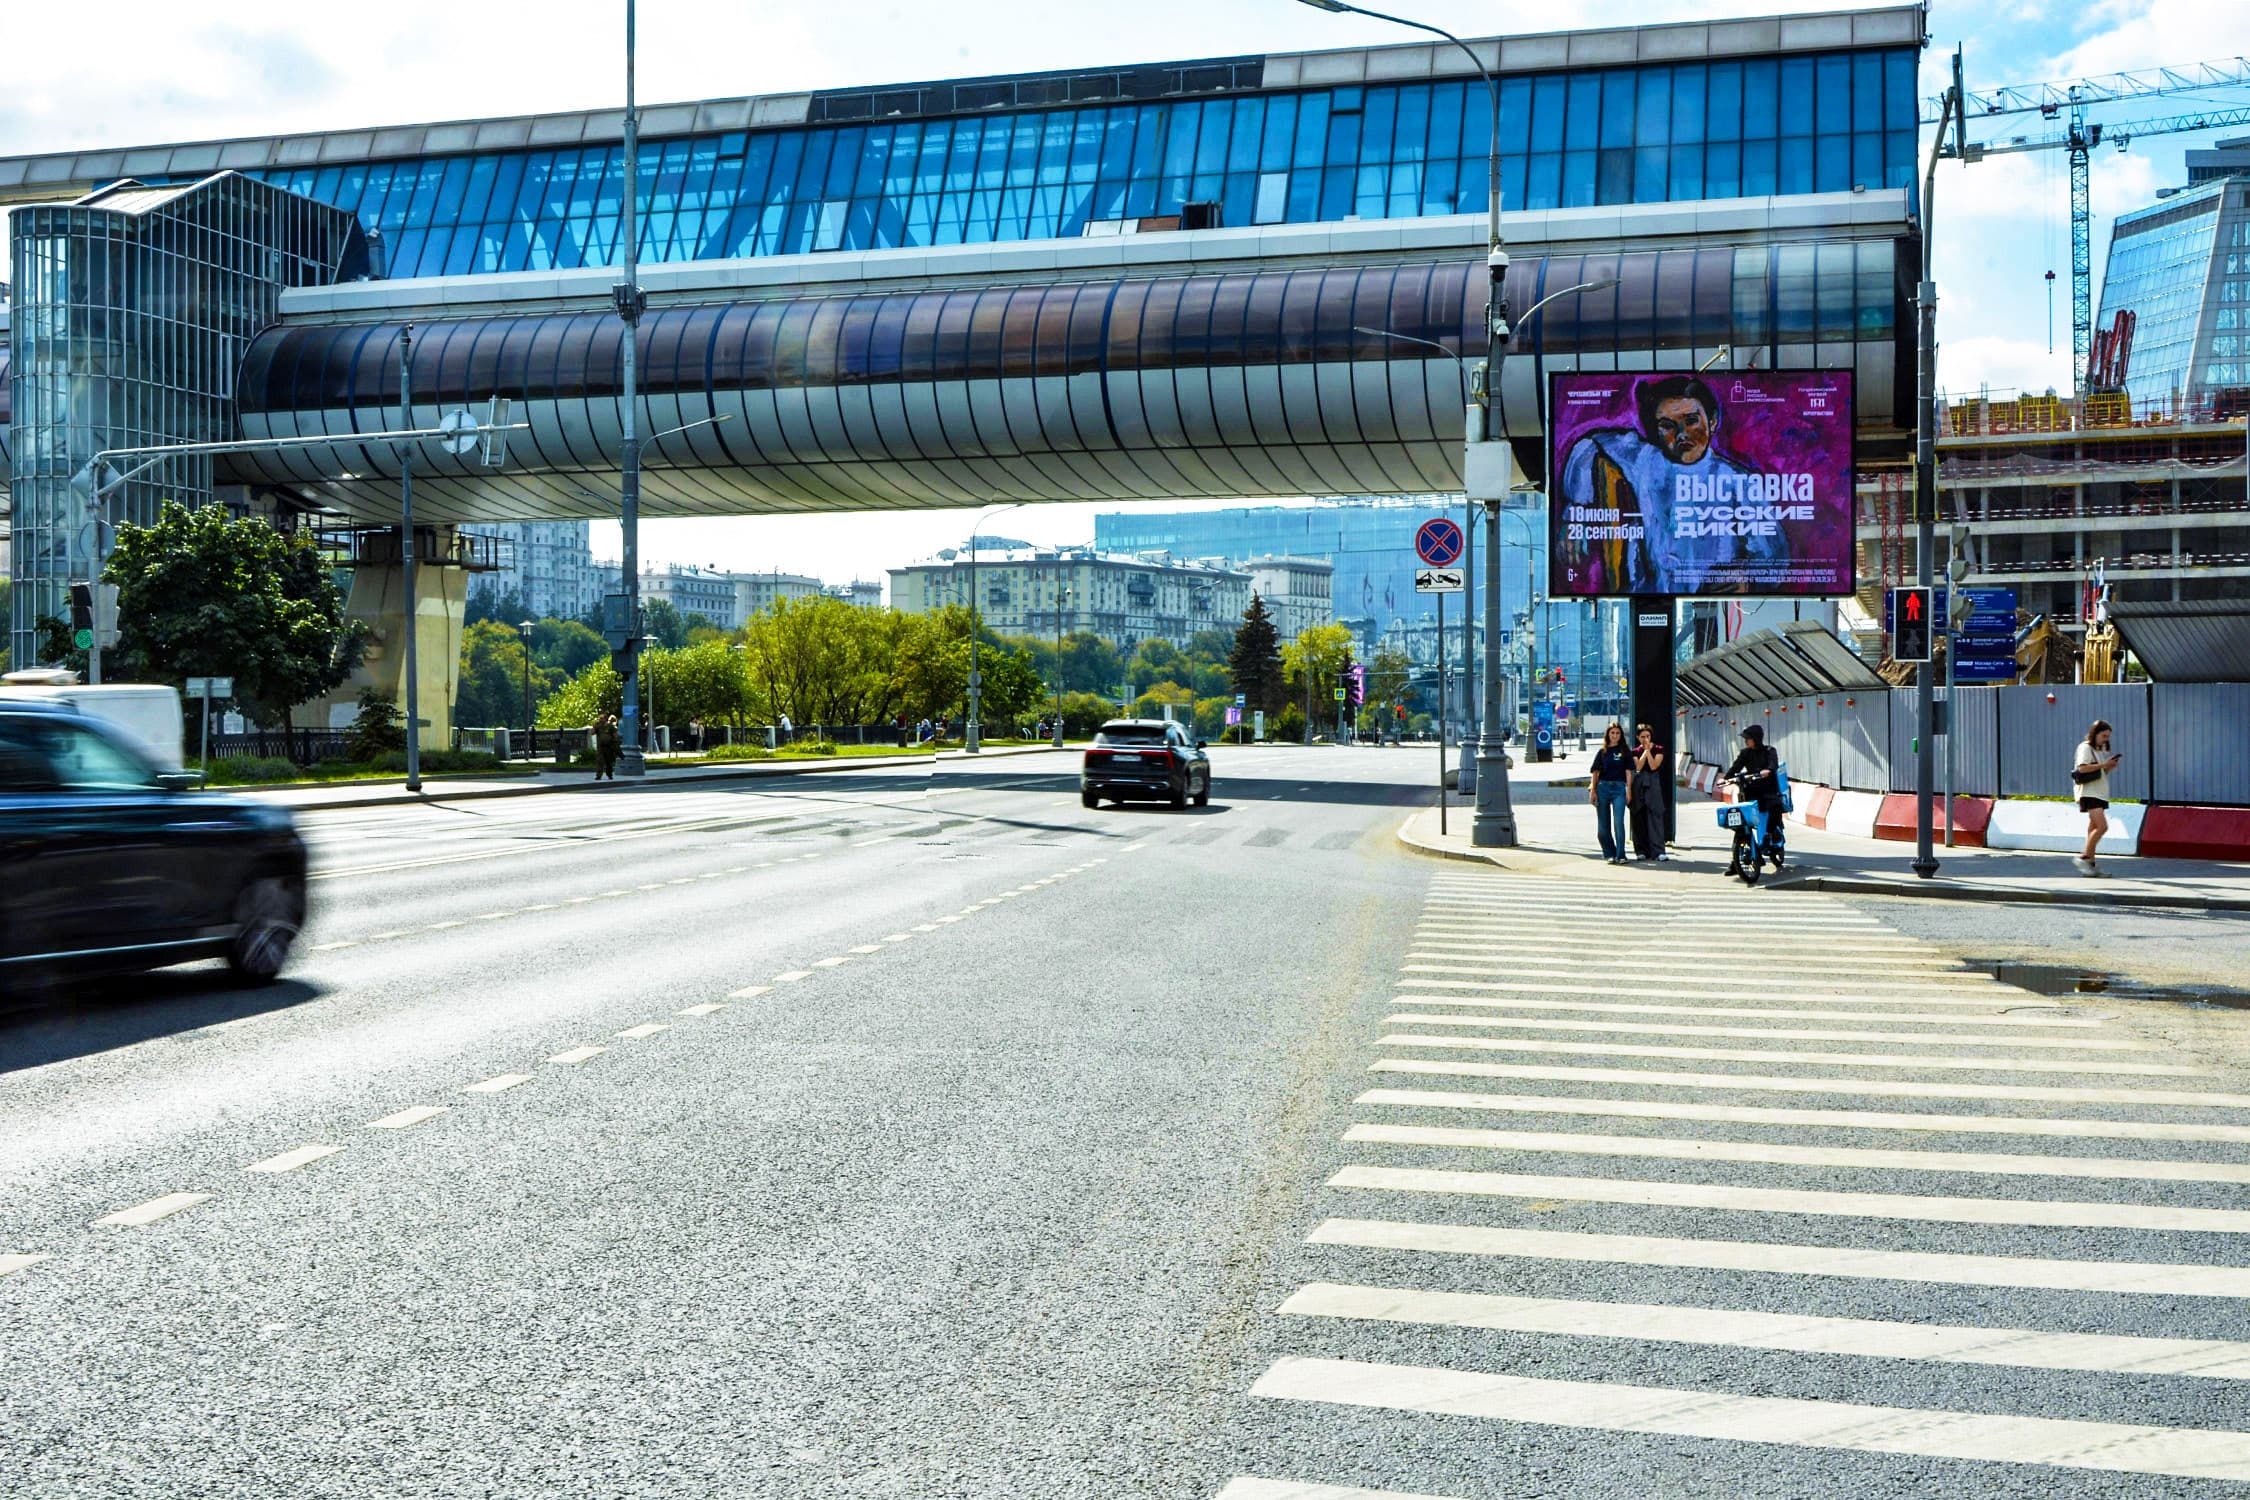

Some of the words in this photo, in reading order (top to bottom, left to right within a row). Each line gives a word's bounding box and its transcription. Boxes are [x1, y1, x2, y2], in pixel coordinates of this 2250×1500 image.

[1568, 506, 1585, 522] 18
[1586, 508, 1620, 522] июня
[1674, 505, 1815, 521] РУССКИЕ
[1568, 524, 1584, 540] 28
[1585, 523, 1644, 542] сентября
[1674, 521, 1777, 538] ДИКИЕ
[1567, 568, 1579, 582] 6+
